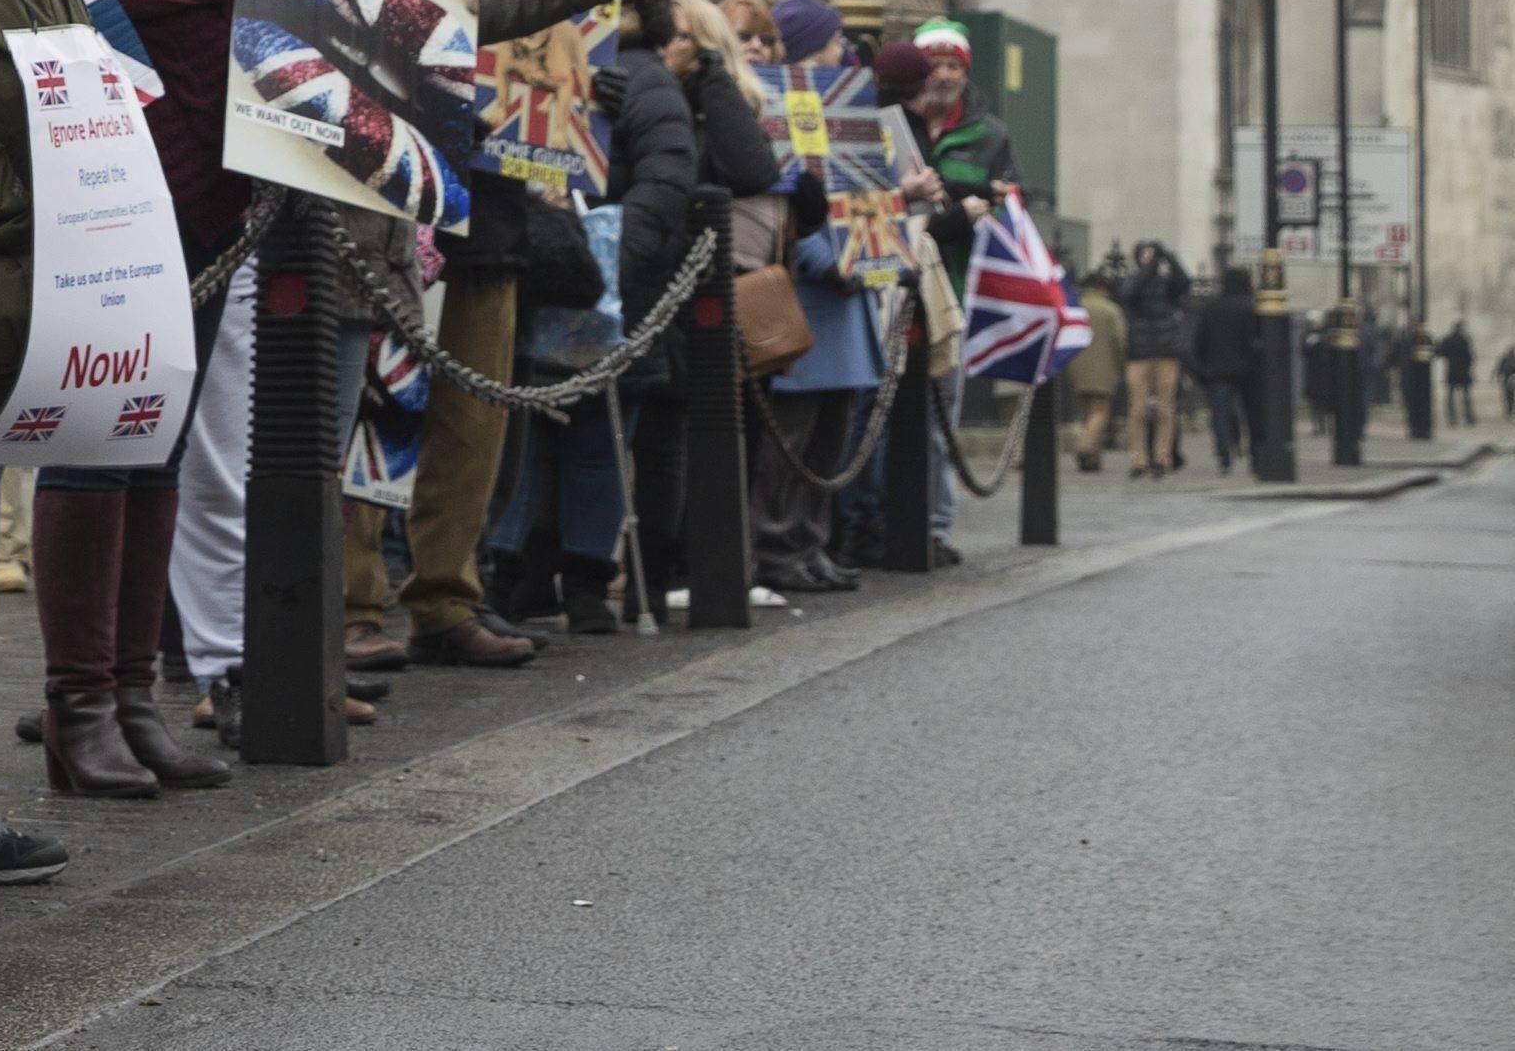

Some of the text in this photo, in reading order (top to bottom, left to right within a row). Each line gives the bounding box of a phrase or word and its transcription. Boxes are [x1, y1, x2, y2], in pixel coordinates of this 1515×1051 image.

[48, 121, 86, 148] Ignore
[88, 115, 121, 139] Article
[236, 102, 341, 141] WE WANT OUT NOW
[78, 164, 127, 189] Repeal the
[57, 212, 88, 225] European
[55, 263, 164, 289] Take us out of the European
[101, 292, 126, 307] Union
[60, 332, 151, 390] Now!
